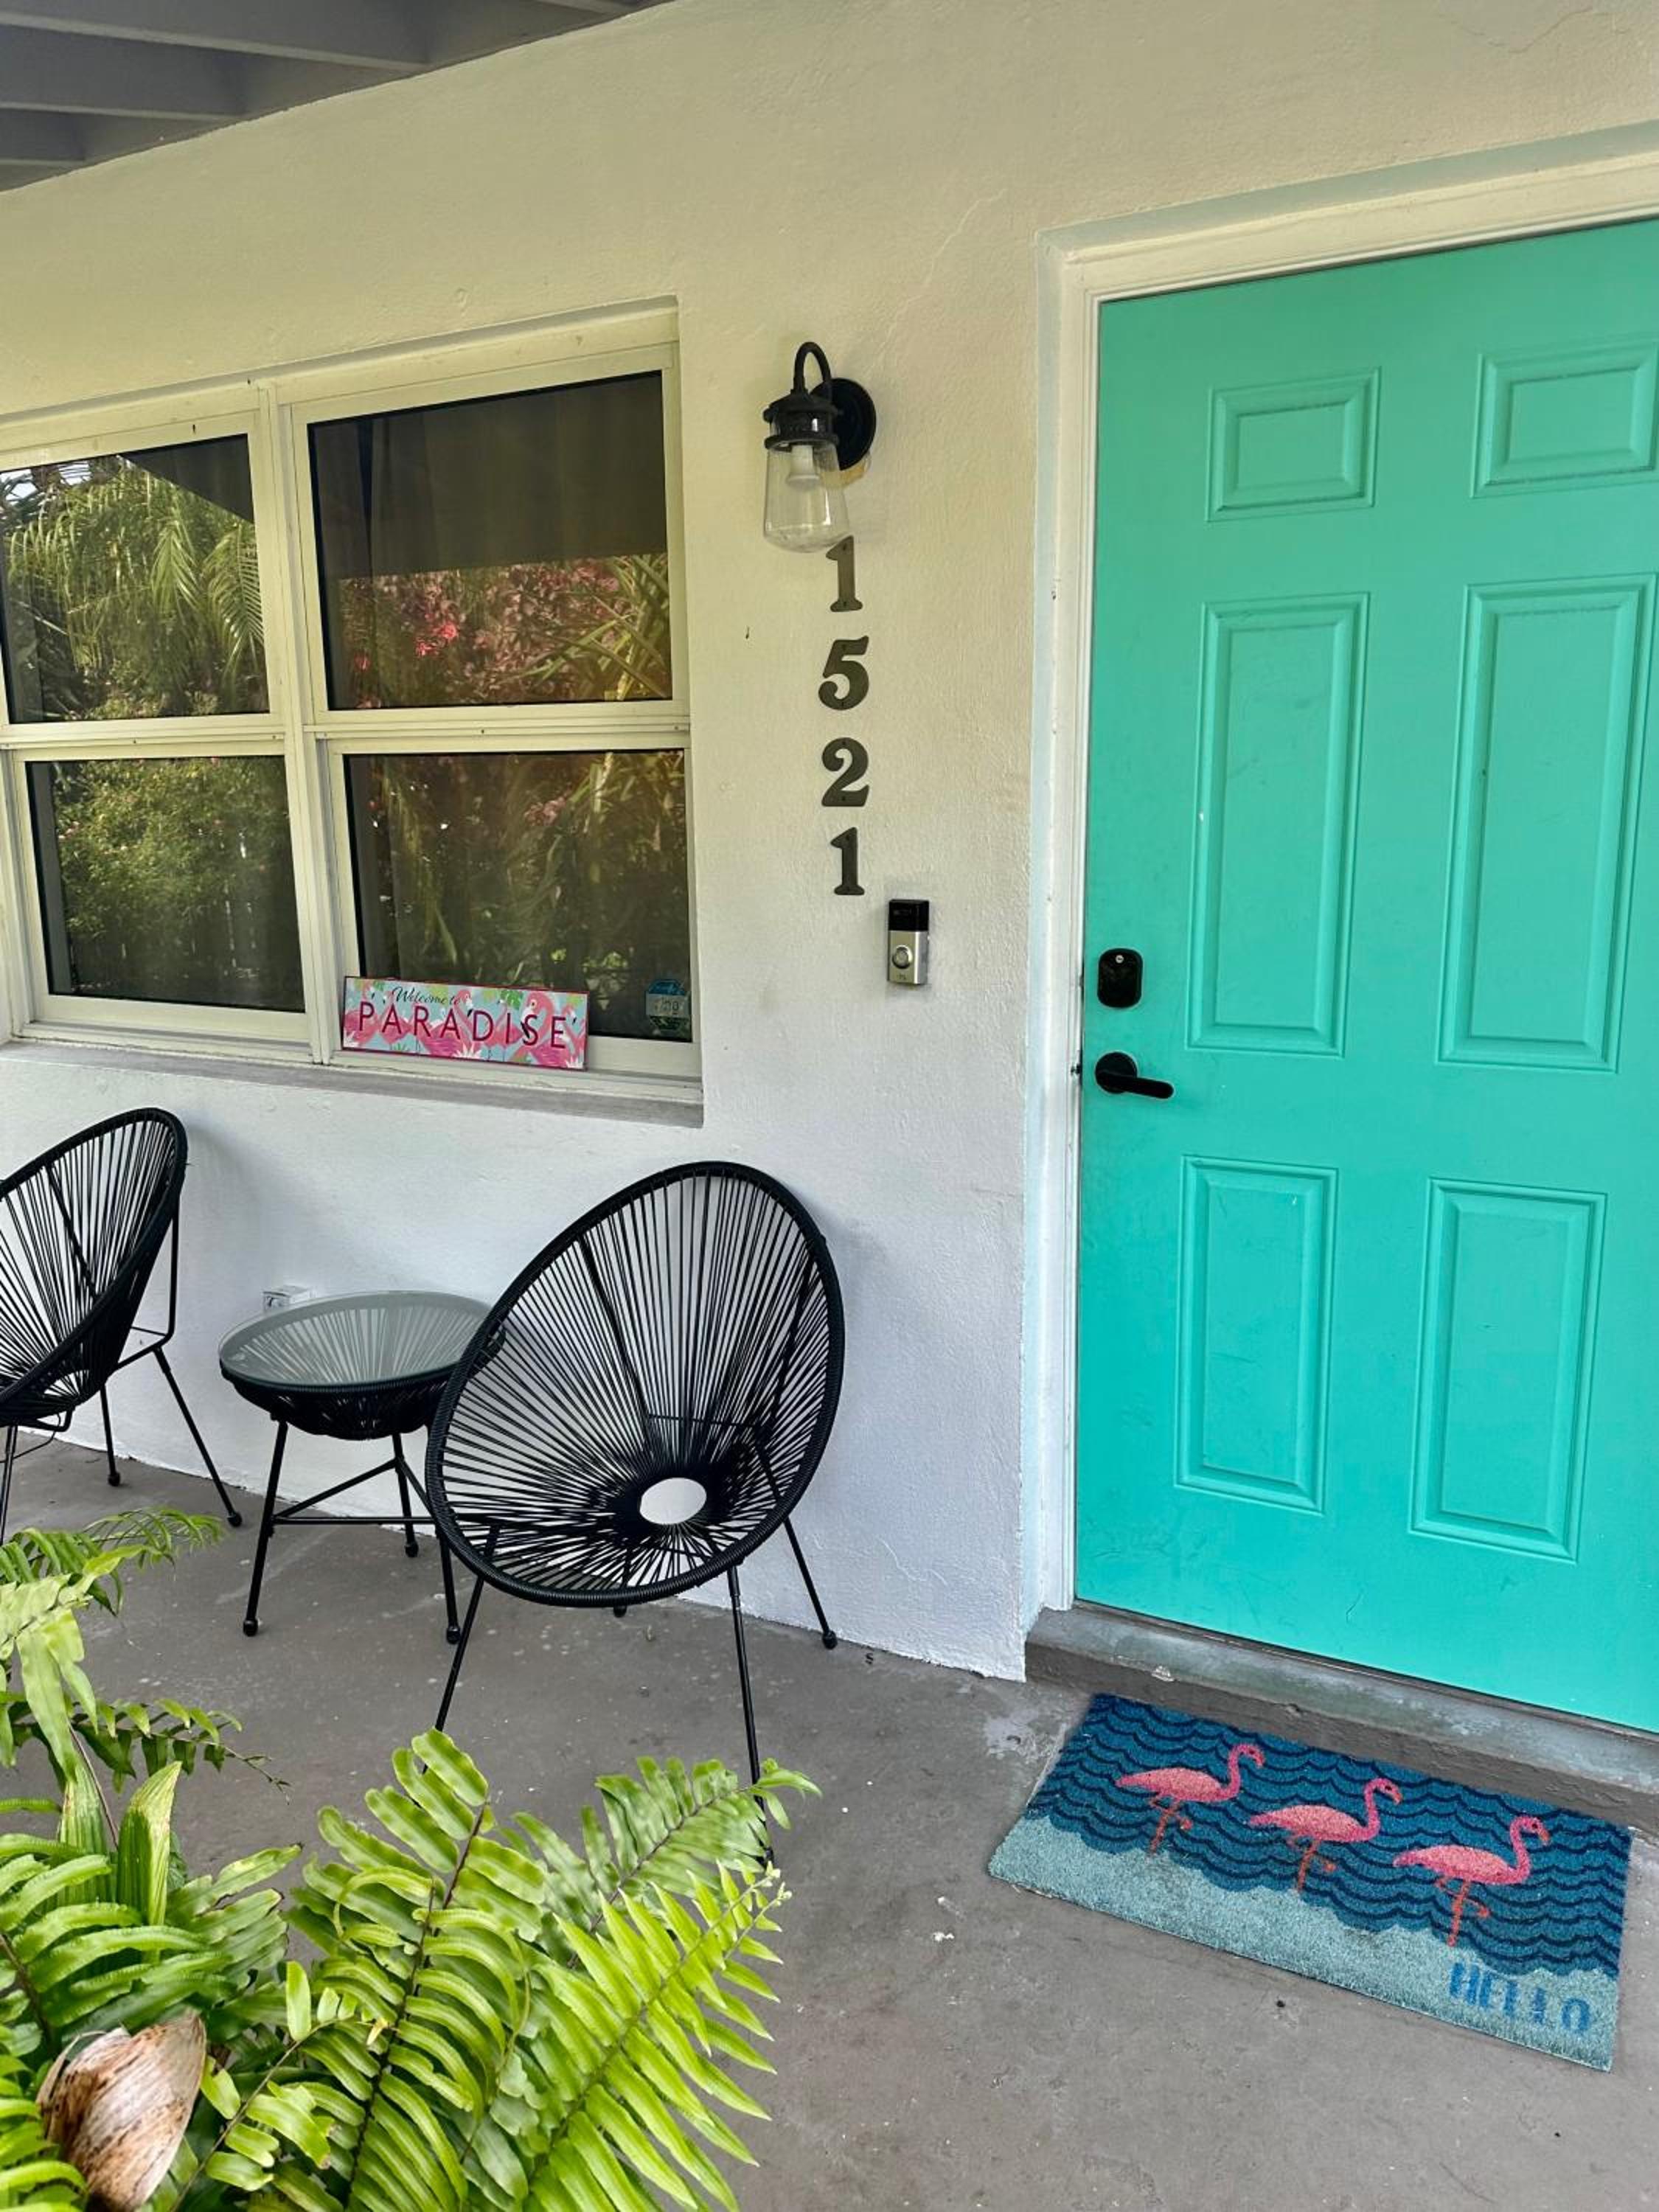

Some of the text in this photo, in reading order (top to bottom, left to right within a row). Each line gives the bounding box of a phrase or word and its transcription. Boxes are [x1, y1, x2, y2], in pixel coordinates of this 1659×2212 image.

[818, 535, 870, 896] 1521
[359, 1001, 566, 1048] PARADISE
[392, 986, 462, 1006] Welcome to
[1449, 1962, 1591, 2034] HELLO
